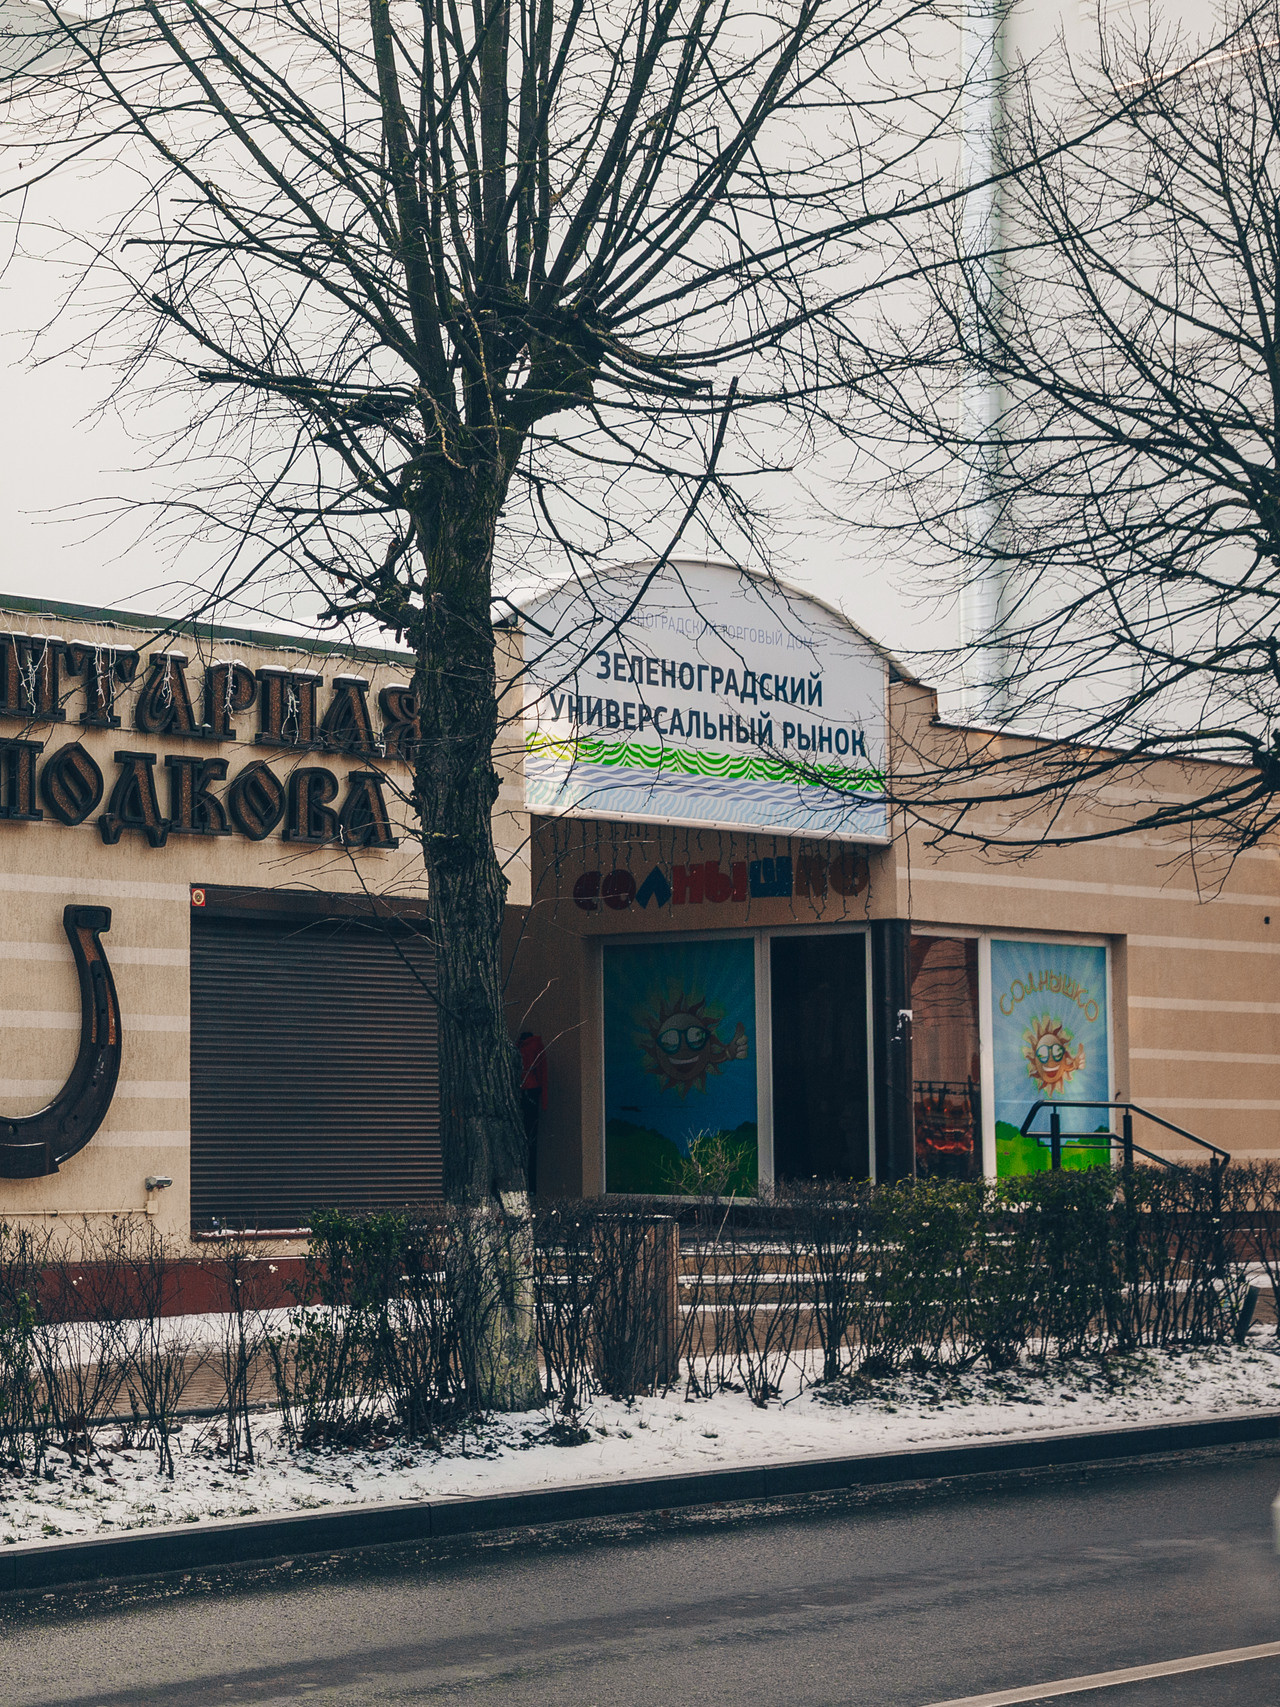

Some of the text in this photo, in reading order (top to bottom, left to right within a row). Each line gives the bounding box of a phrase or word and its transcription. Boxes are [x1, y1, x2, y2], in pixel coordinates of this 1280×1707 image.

[607, 606, 814, 650] ЗЕНОГРАДСКИЙ ТОРГОВЫЙ ДОМ
[597, 649, 823, 707] ЗЕЛЕНОГРАДСКИЙ
[549, 693, 866, 757] УНИВЕРСАЛЬНЫЙ РЫНОК
[572, 850, 870, 911] СОЛНЫШКО
[999, 969, 1099, 1022] СОЛНЫШКО
